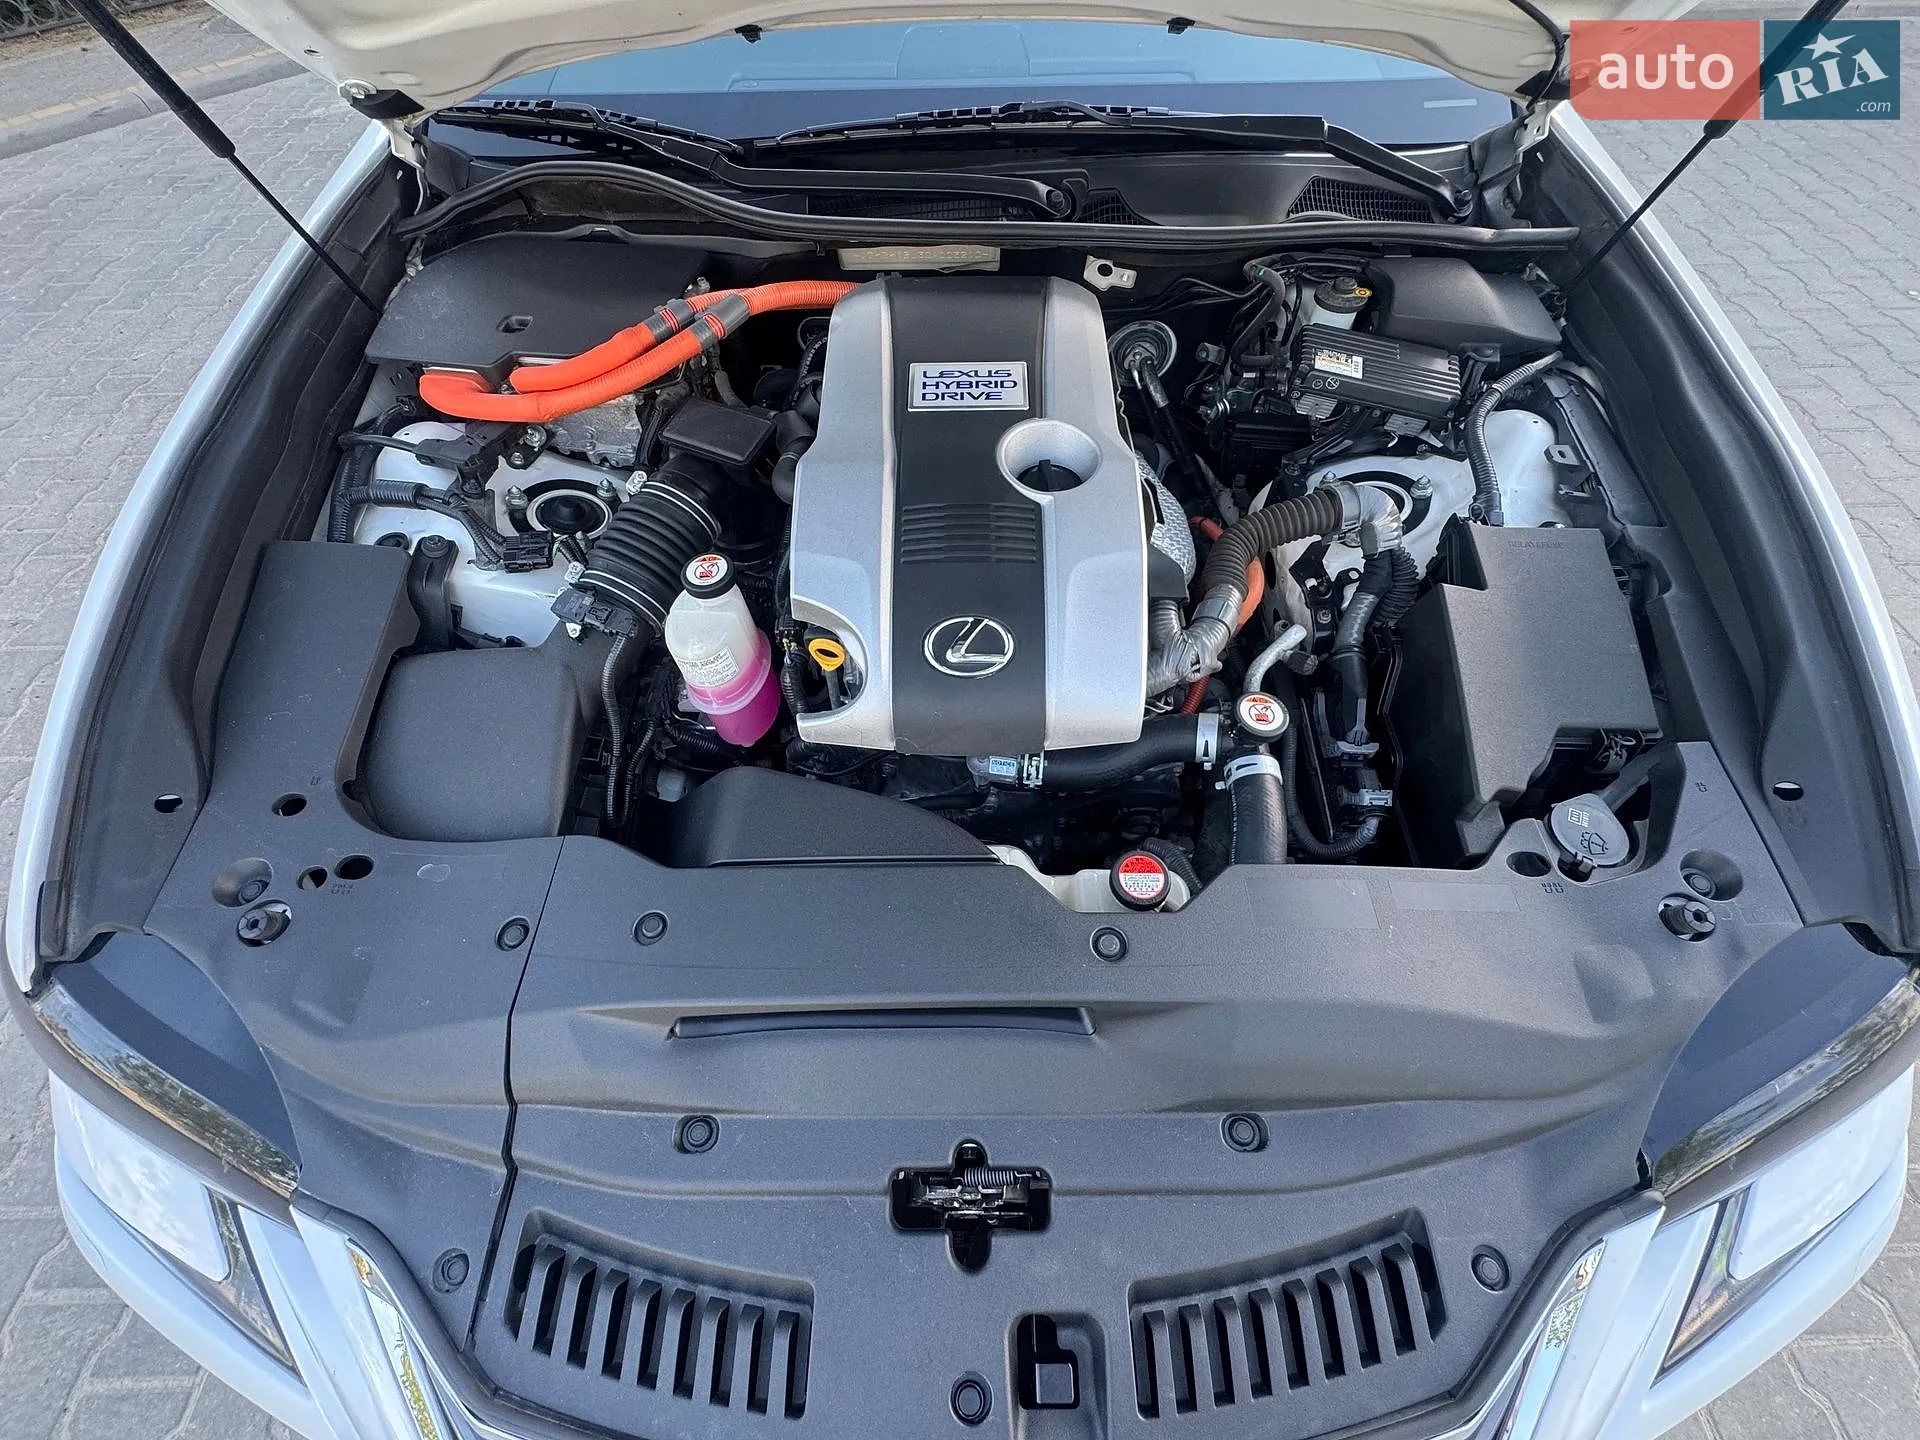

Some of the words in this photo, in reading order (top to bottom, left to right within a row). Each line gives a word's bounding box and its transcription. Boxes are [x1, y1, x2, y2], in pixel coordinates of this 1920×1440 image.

[922, 369, 1012, 378] LEXUS
[922, 380, 1018, 389] HYBRID
[921, 391, 1003, 400] DRIVE
